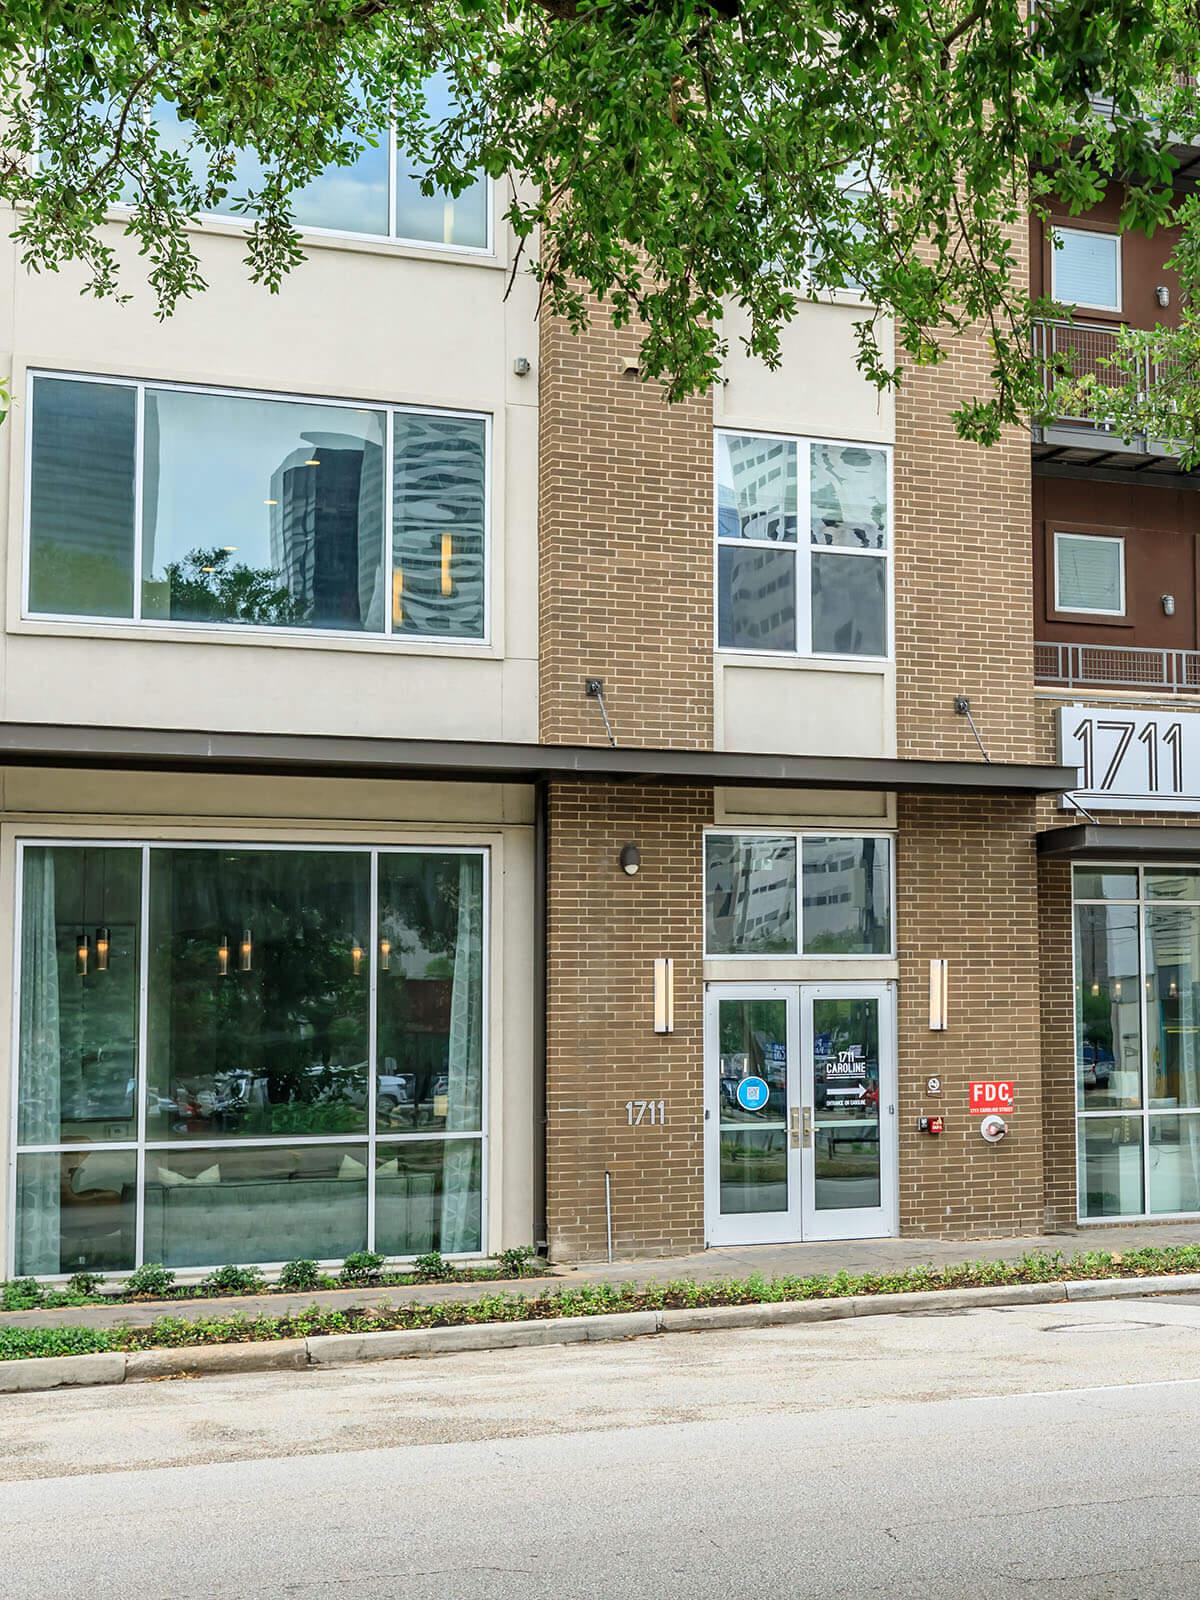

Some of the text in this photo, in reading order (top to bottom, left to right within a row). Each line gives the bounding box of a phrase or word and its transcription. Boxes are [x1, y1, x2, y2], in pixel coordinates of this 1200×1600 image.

[1073, 719, 1182, 792] 1711
[838, 1051, 855, 1062] 1711
[826, 1062, 866, 1074] CAROLINE
[973, 1083, 1009, 1102] FDC
[626, 1100, 665, 1125] 1711
